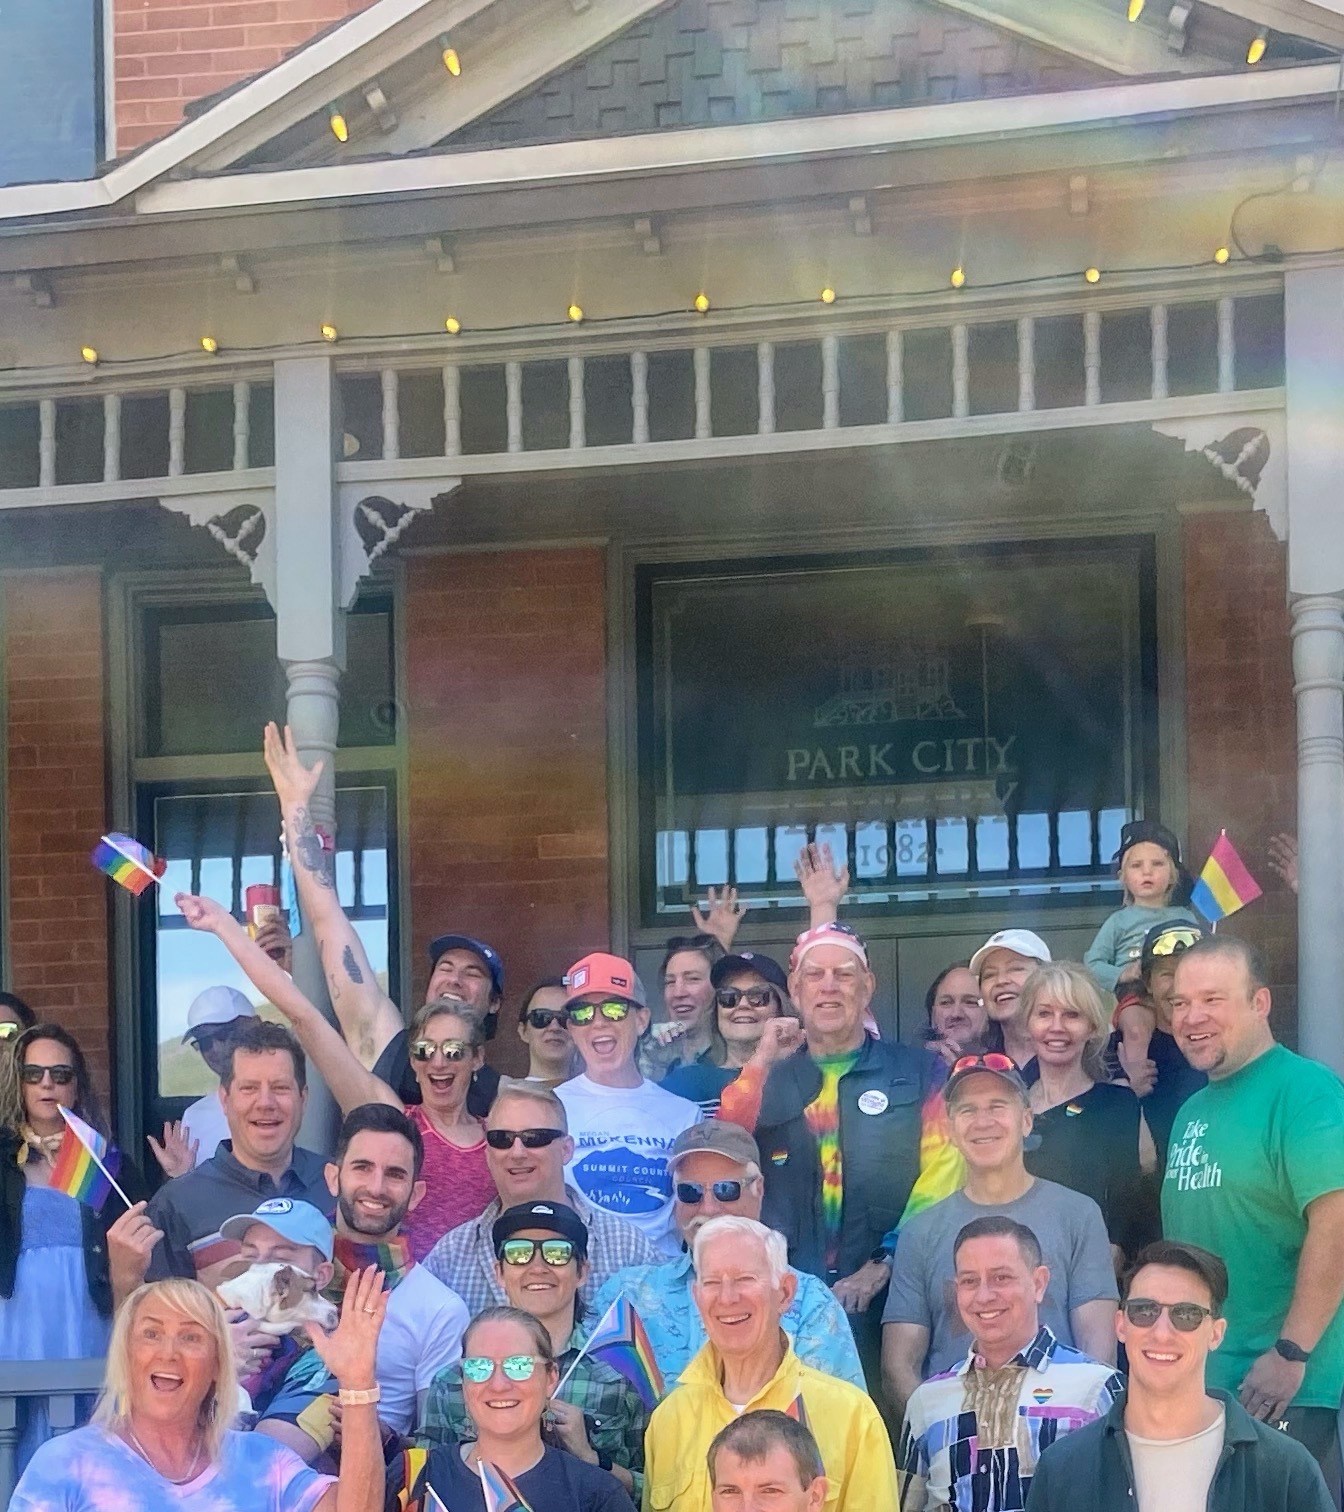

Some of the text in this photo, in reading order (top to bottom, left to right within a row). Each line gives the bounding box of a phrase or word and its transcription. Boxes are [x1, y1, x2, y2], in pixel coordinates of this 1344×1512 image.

[786, 735, 1017, 781] PARK CITY
[582, 1163, 669, 1177] SUMMIT COUNT
[1178, 1161, 1222, 1191] Health
